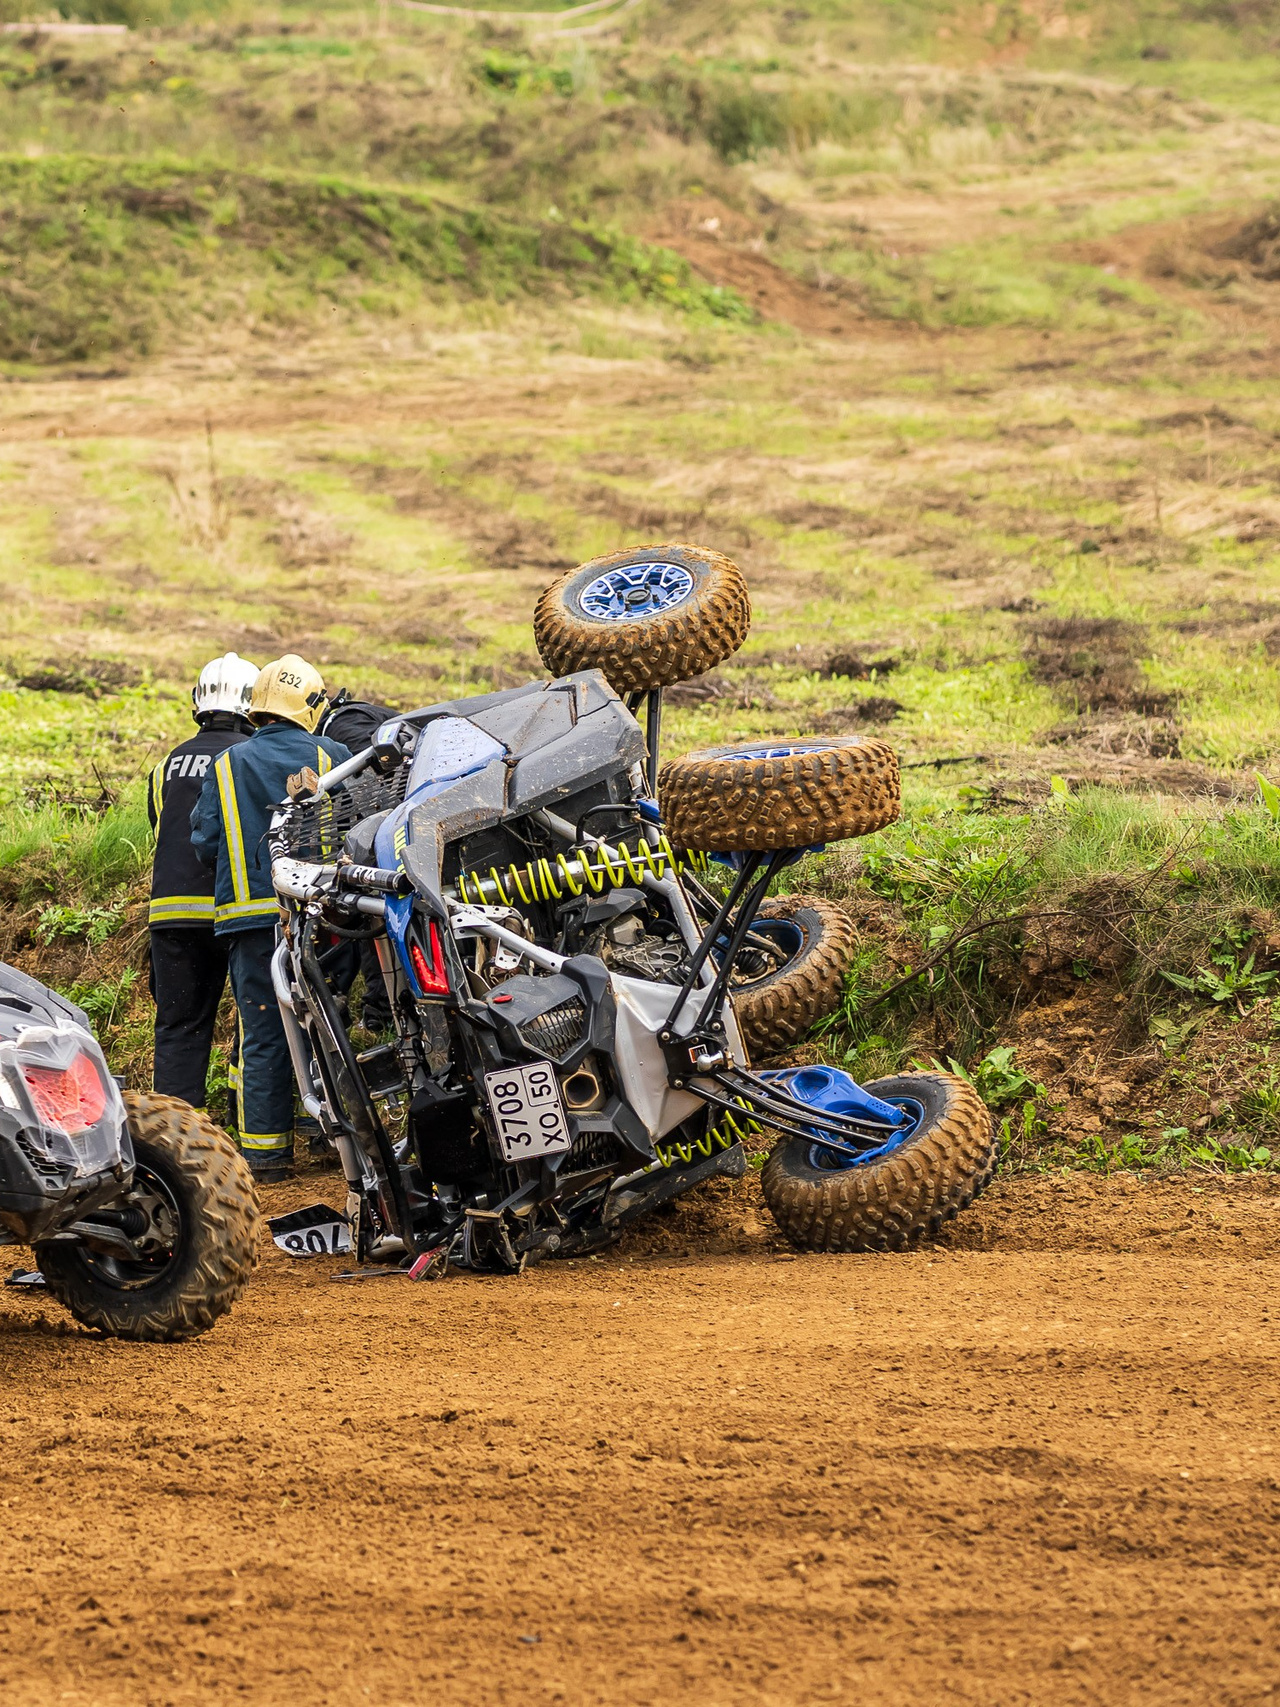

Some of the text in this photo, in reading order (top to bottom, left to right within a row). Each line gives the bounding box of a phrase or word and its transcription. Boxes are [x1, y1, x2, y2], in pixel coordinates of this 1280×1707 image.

[279, 671, 302, 689] 232
[353, 866, 376, 881] FOX
[528, 1071, 552, 1098] 50
[493, 1081, 532, 1150] 3708
